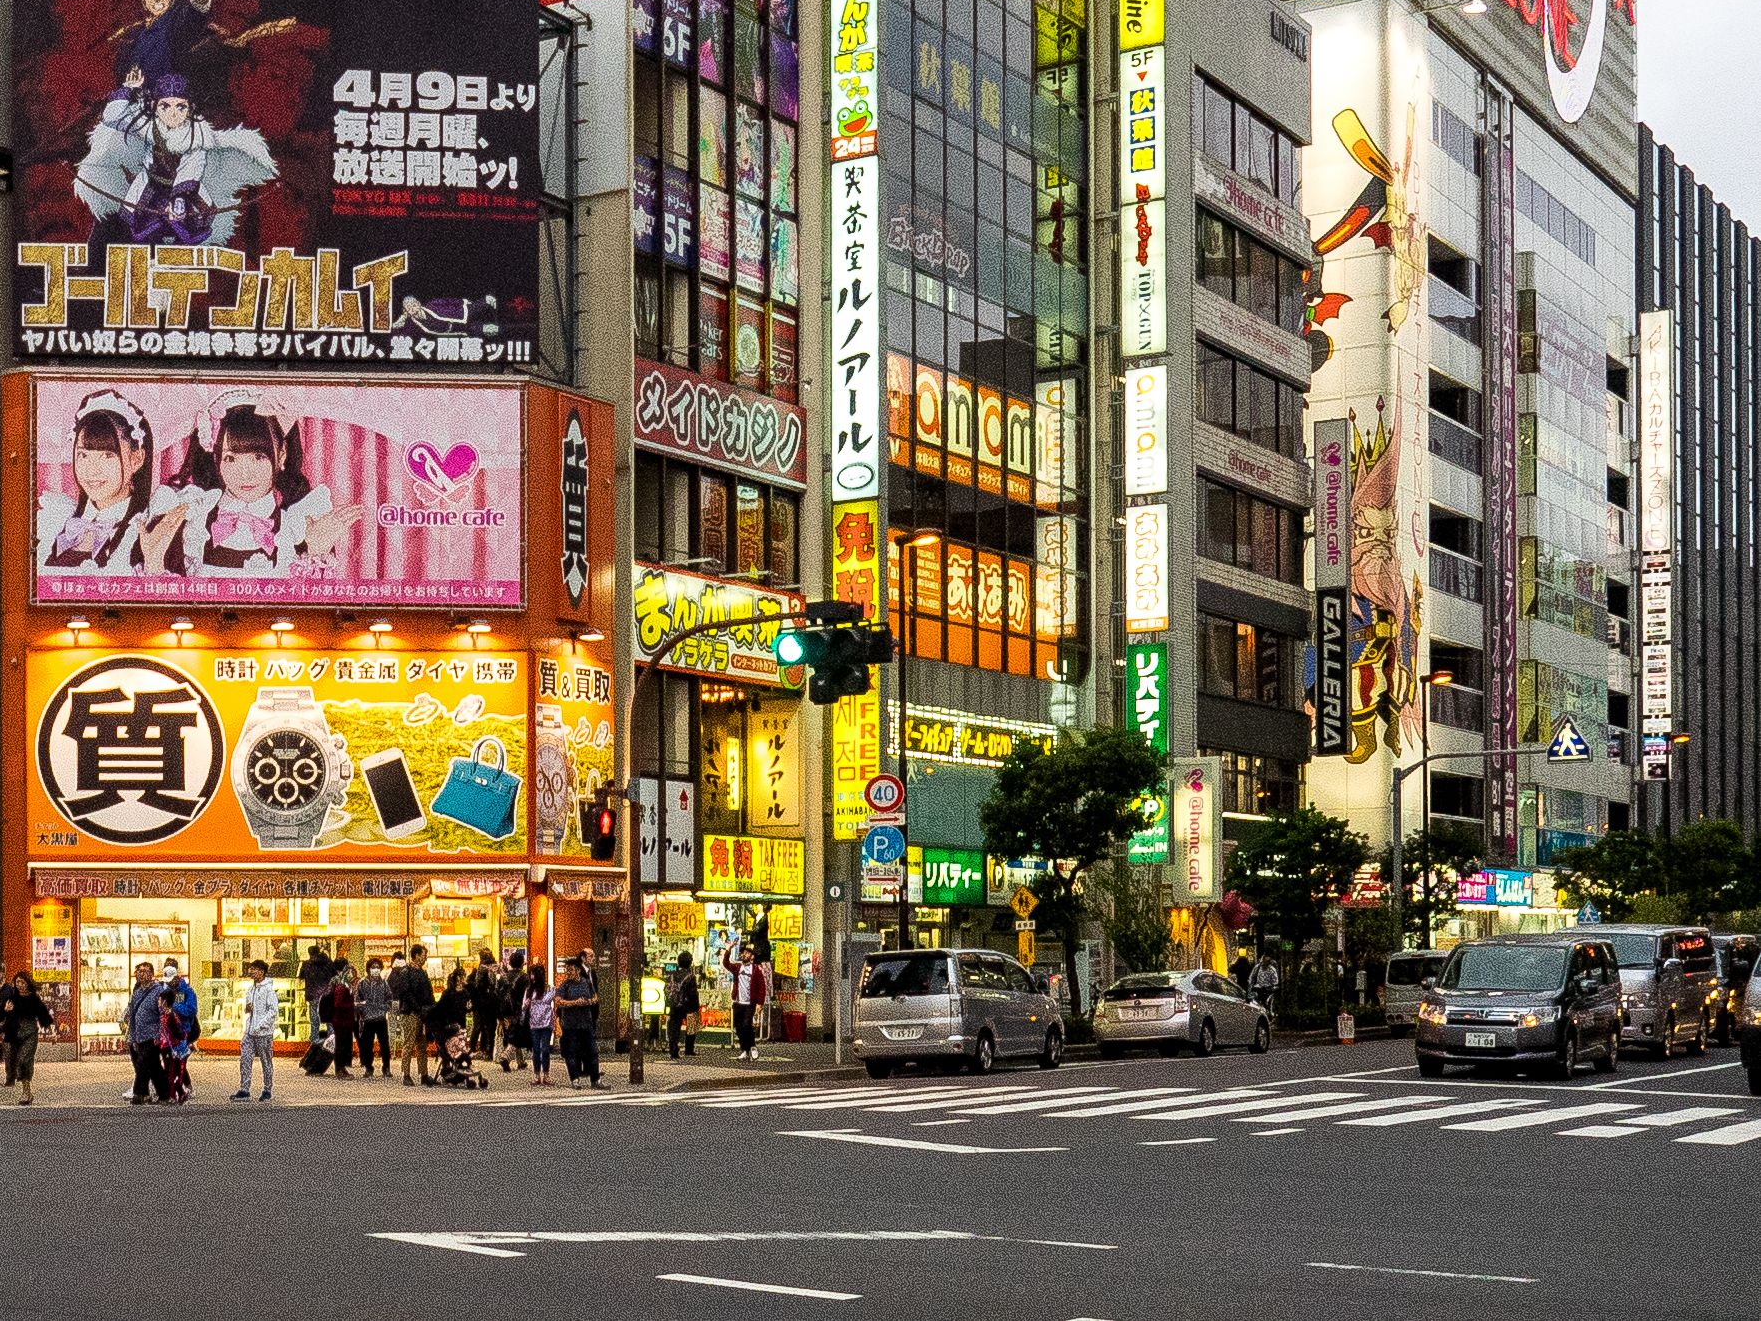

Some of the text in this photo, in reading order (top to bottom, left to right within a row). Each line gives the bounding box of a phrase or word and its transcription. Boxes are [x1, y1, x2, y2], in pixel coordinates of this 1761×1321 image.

[663, 16, 691, 63] 6F
[1130, 50, 1155, 68] 5F
[333, 69, 537, 113] 4月9日より
[663, 211, 691, 257] 5F
[18, 242, 409, 335] ゴールデンカムイ
[836, 167, 873, 453] 喫茶室ルノアール
[638, 370, 803, 480] メイドカジノ
[1135, 373, 1157, 489] amiami
[376, 505, 507, 529] @home cafe
[1325, 470, 1342, 567] @home cafe
[636, 569, 782, 654] まんが喫茶
[215, 658, 257, 682] 時計
[406, 658, 469, 682] ダイヤ
[474, 658, 518, 683] 携帯
[1323, 596, 1342, 748] GALLERIA
[835, 695, 858, 782] 세점
[859, 702, 877, 781] FREE
[873, 785, 897, 802] 40
[709, 837, 753, 879] 免税
[759, 840, 799, 868] TAX FREE
[873, 835, 889, 860] P
[1189, 796, 1204, 892] @home cafe
[925, 863, 982, 888] リバティー
